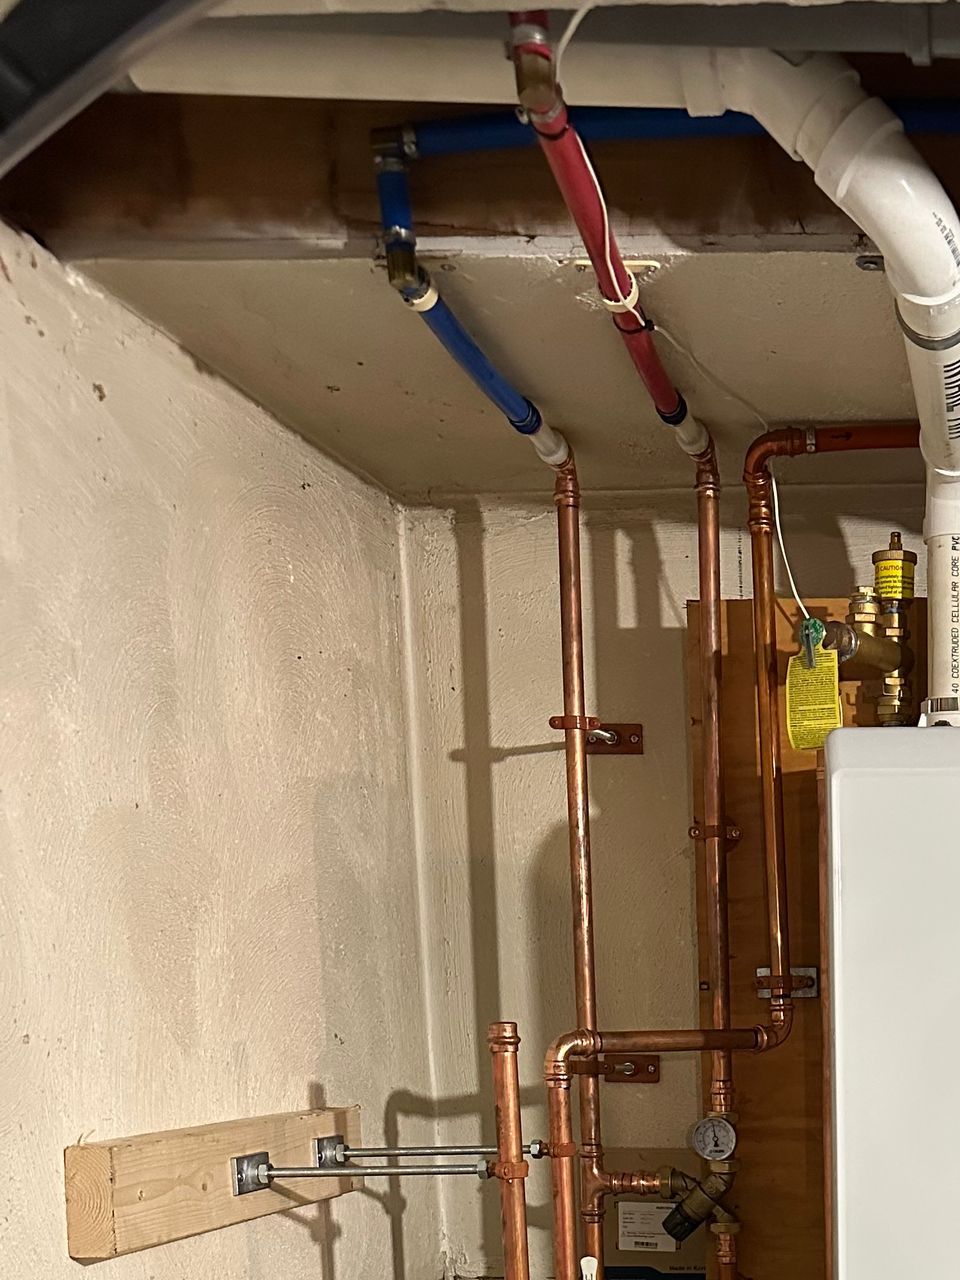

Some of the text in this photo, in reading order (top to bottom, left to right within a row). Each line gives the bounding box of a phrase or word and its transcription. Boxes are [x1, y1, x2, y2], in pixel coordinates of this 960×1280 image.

[951, 555, 960, 577] CORE
[951, 581, 960, 623] CELLULAR
[951, 627, 960, 679] COEXTRUDED
